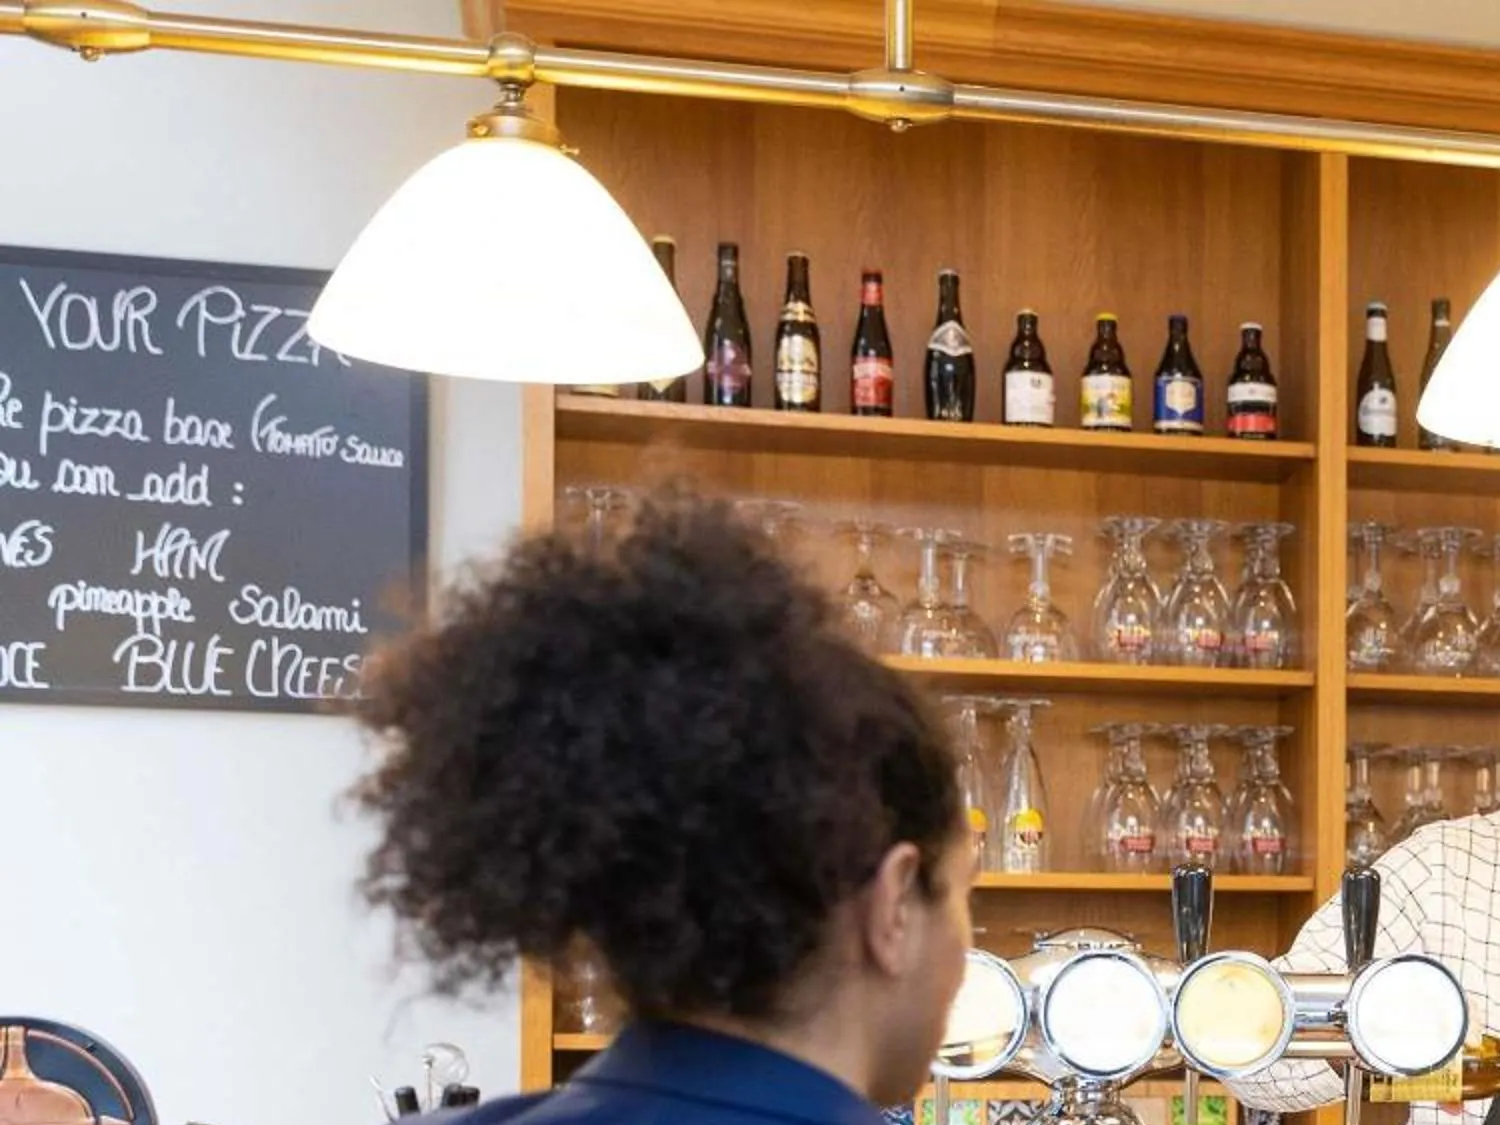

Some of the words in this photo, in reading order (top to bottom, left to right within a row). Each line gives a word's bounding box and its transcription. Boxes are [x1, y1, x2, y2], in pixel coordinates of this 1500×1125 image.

[19, 278, 163, 355] YOUR
[40, 391, 150, 456] pizza
[164, 397, 234, 449] base
[52, 460, 120, 498] can
[127, 462, 212, 507] add
[132, 523, 231, 581] HAM
[47, 580, 195, 637] pineapple
[228, 584, 368, 633] Salami
[112, 634, 234, 696] BLUE
